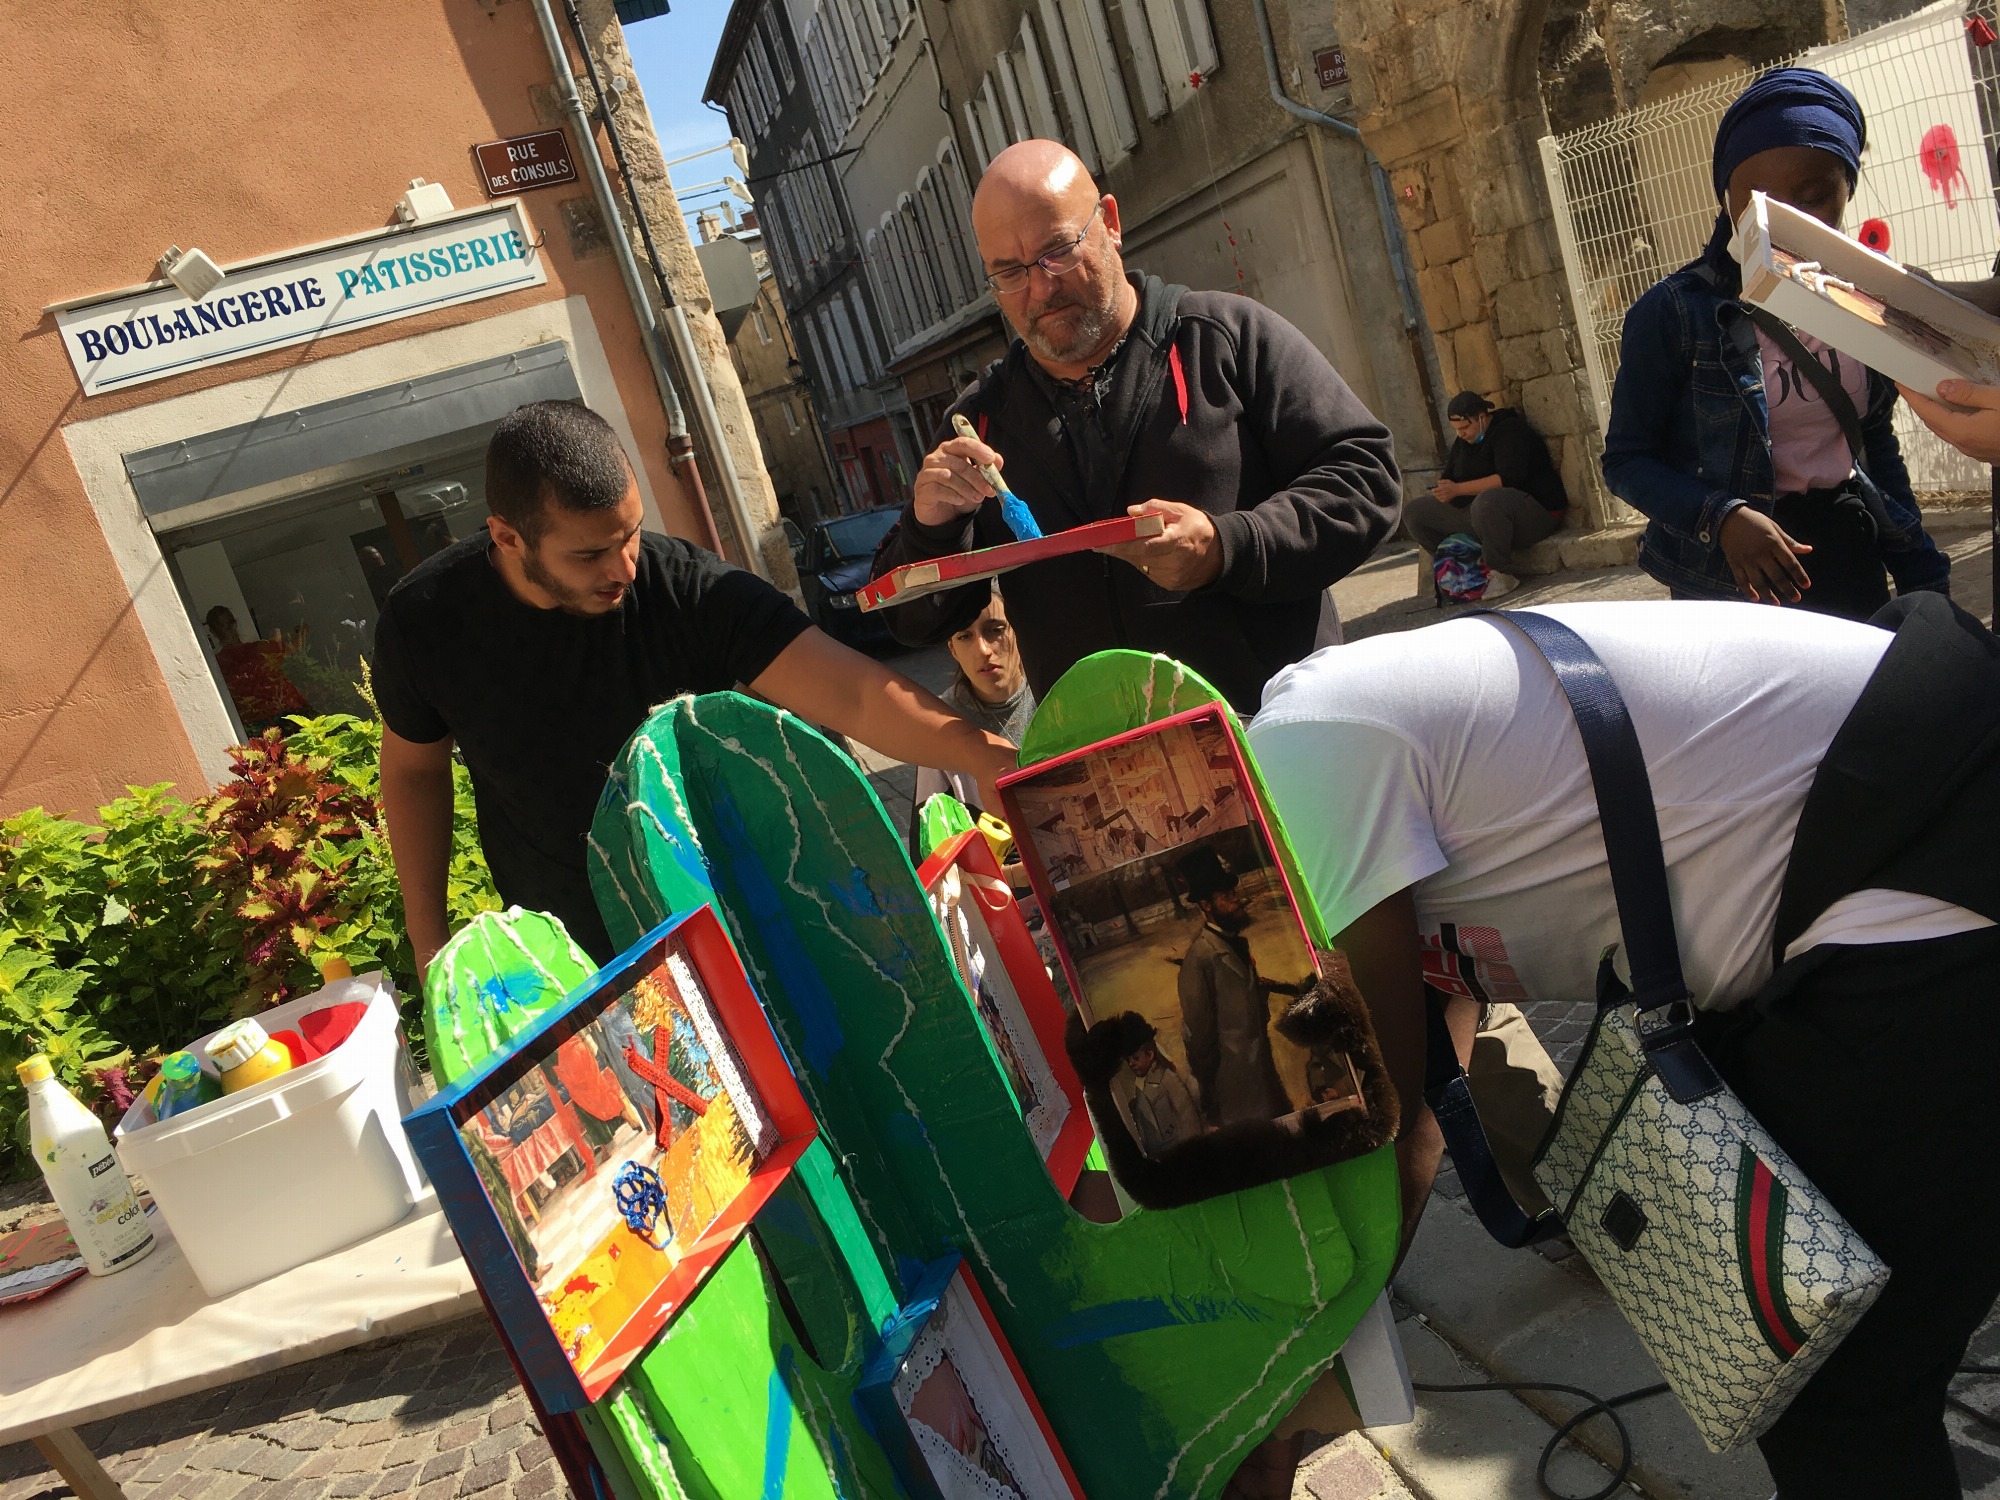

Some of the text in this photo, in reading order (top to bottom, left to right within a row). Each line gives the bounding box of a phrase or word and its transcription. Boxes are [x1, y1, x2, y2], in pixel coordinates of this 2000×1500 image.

[506, 142, 539, 162] RUE
[491, 159, 569, 187] DES CONSULS
[76, 230, 526, 363] BOULANGERIE PATISSERIE
